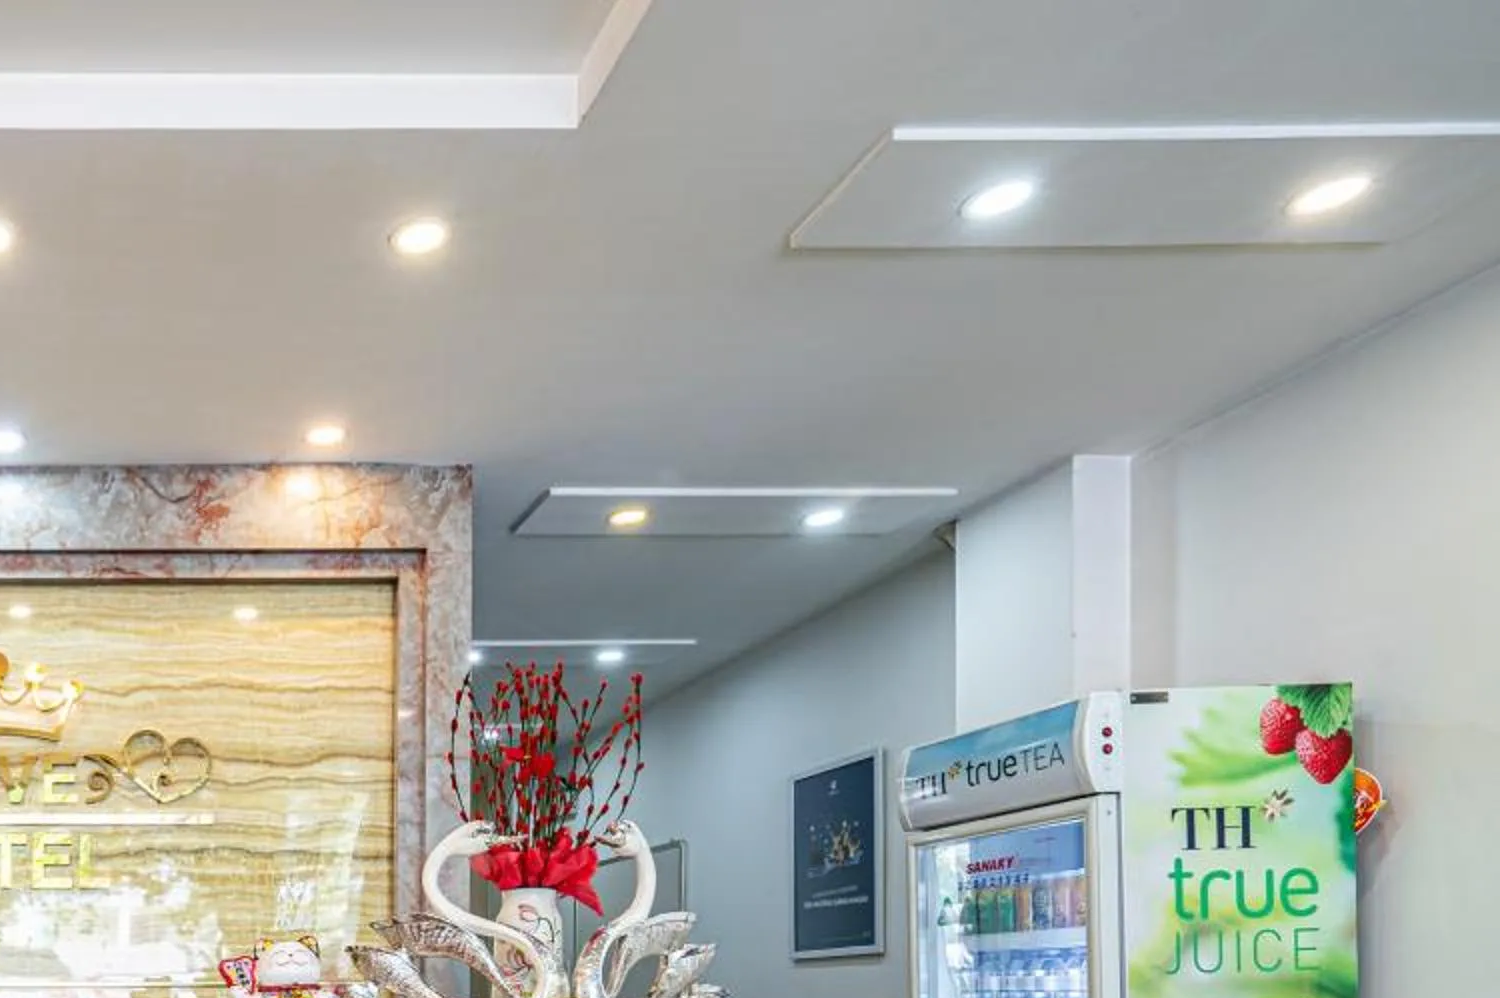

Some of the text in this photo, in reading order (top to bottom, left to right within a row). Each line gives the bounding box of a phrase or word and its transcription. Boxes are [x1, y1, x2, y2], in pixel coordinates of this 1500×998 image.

[915, 771, 947, 799] TH
[1170, 806, 1258, 852] TH
[1166, 857, 1320, 921] true
[1164, 927, 1323, 976] JUICE
